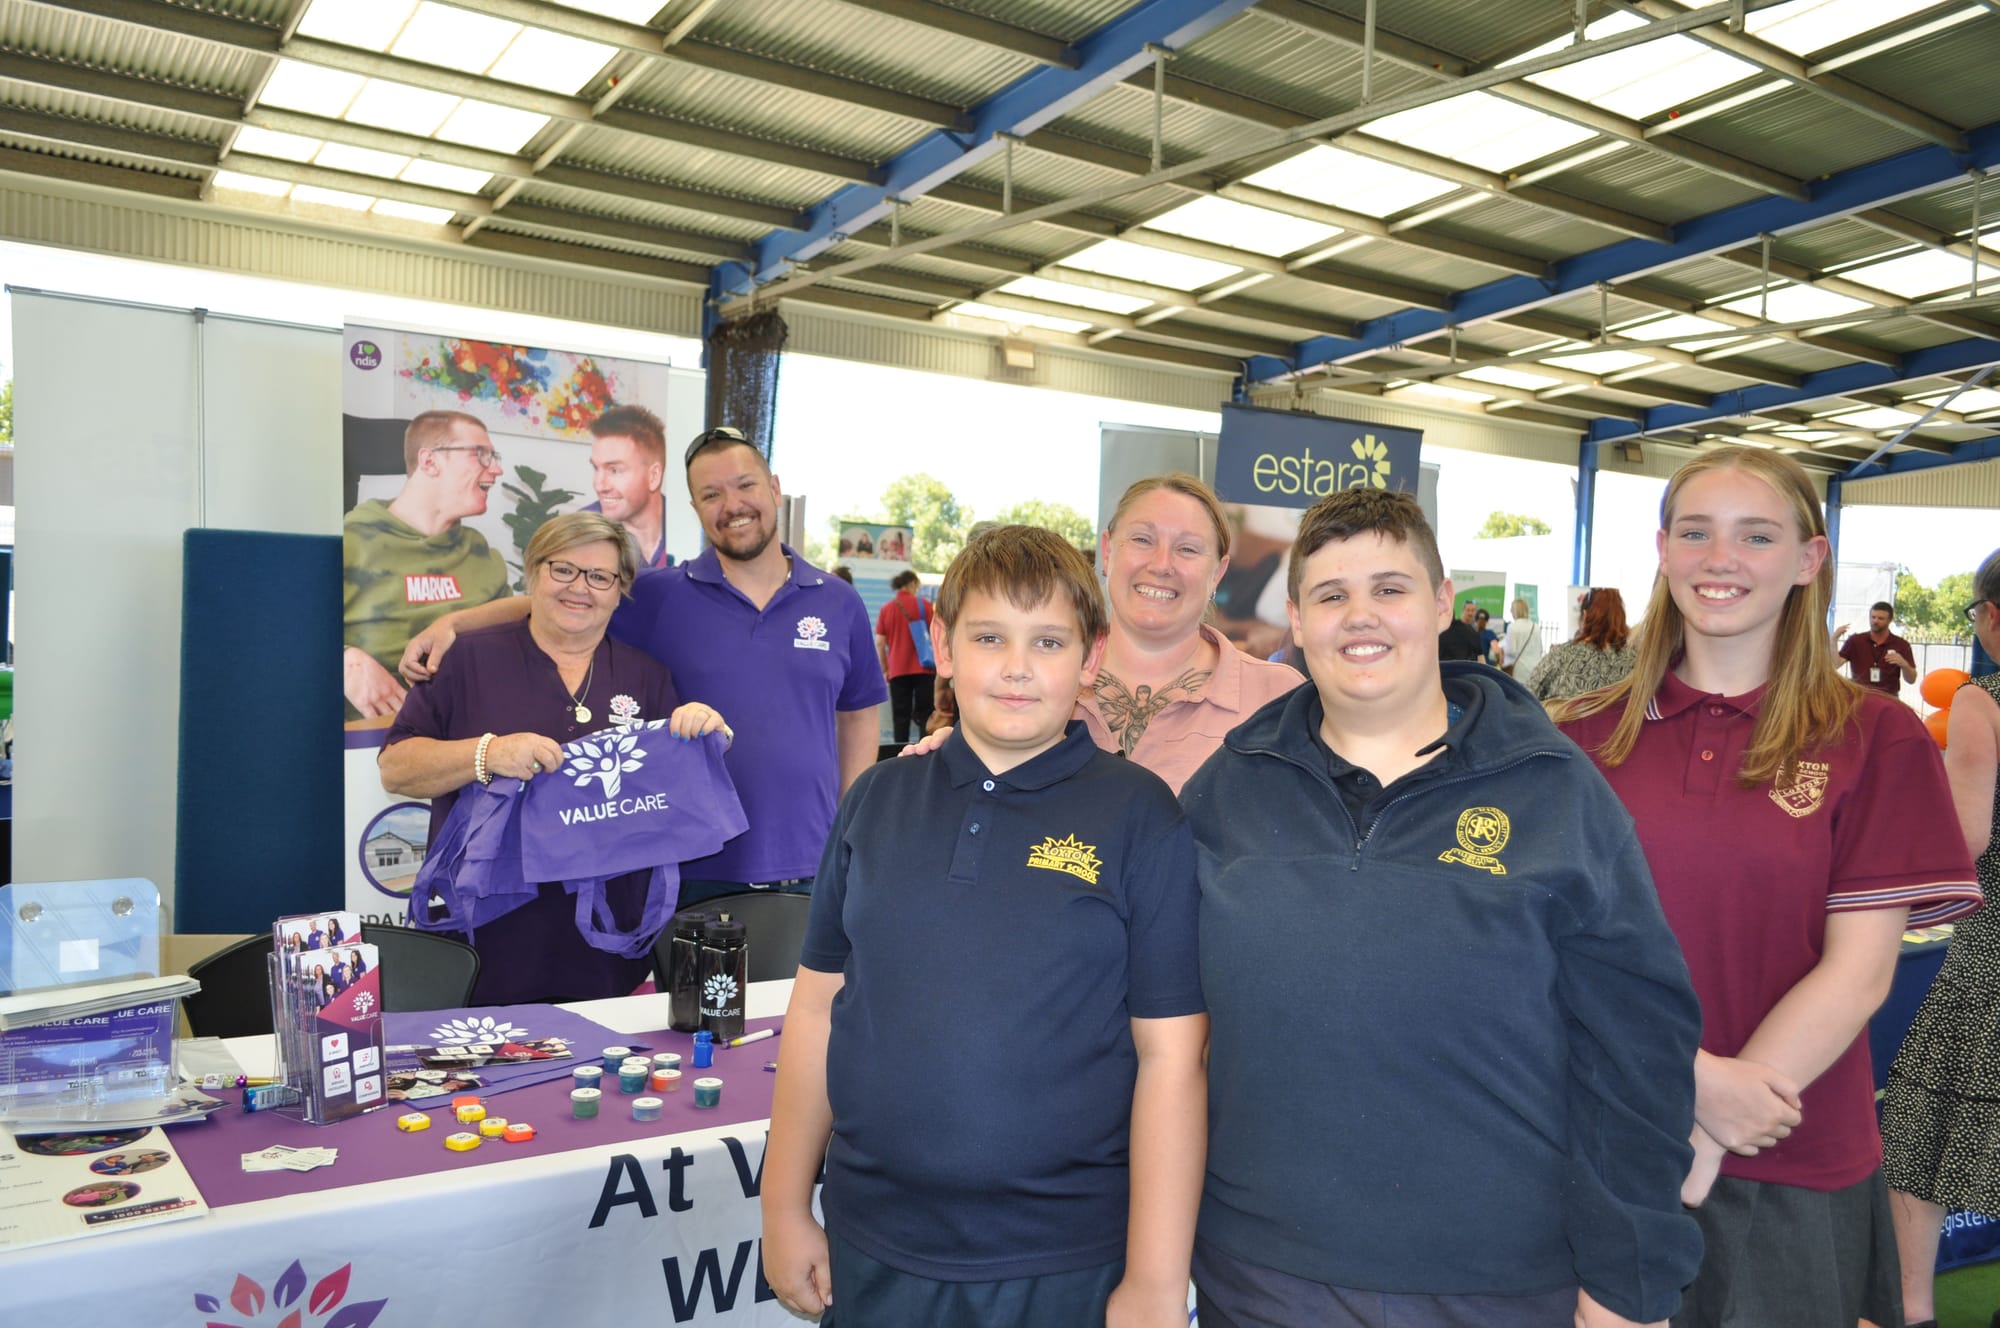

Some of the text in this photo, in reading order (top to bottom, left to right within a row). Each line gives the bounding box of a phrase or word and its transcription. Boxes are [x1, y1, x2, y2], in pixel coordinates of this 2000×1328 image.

[355, 355, 378, 368] ndis
[1253, 447, 1369, 498] estara
[406, 575, 462, 602] MARVEL
[1796, 760, 1830, 772] XTON
[559, 792, 669, 826] VALUE CARE
[1043, 847, 1091, 864] LOXTON
[1027, 857, 1097, 882] PRIMARY SCHOOL
[137, 1005, 172, 1017] CARE
[721, 1007, 742, 1018] CARE
[73, 1016, 110, 1026] CARE
[588, 1146, 694, 1229] At
